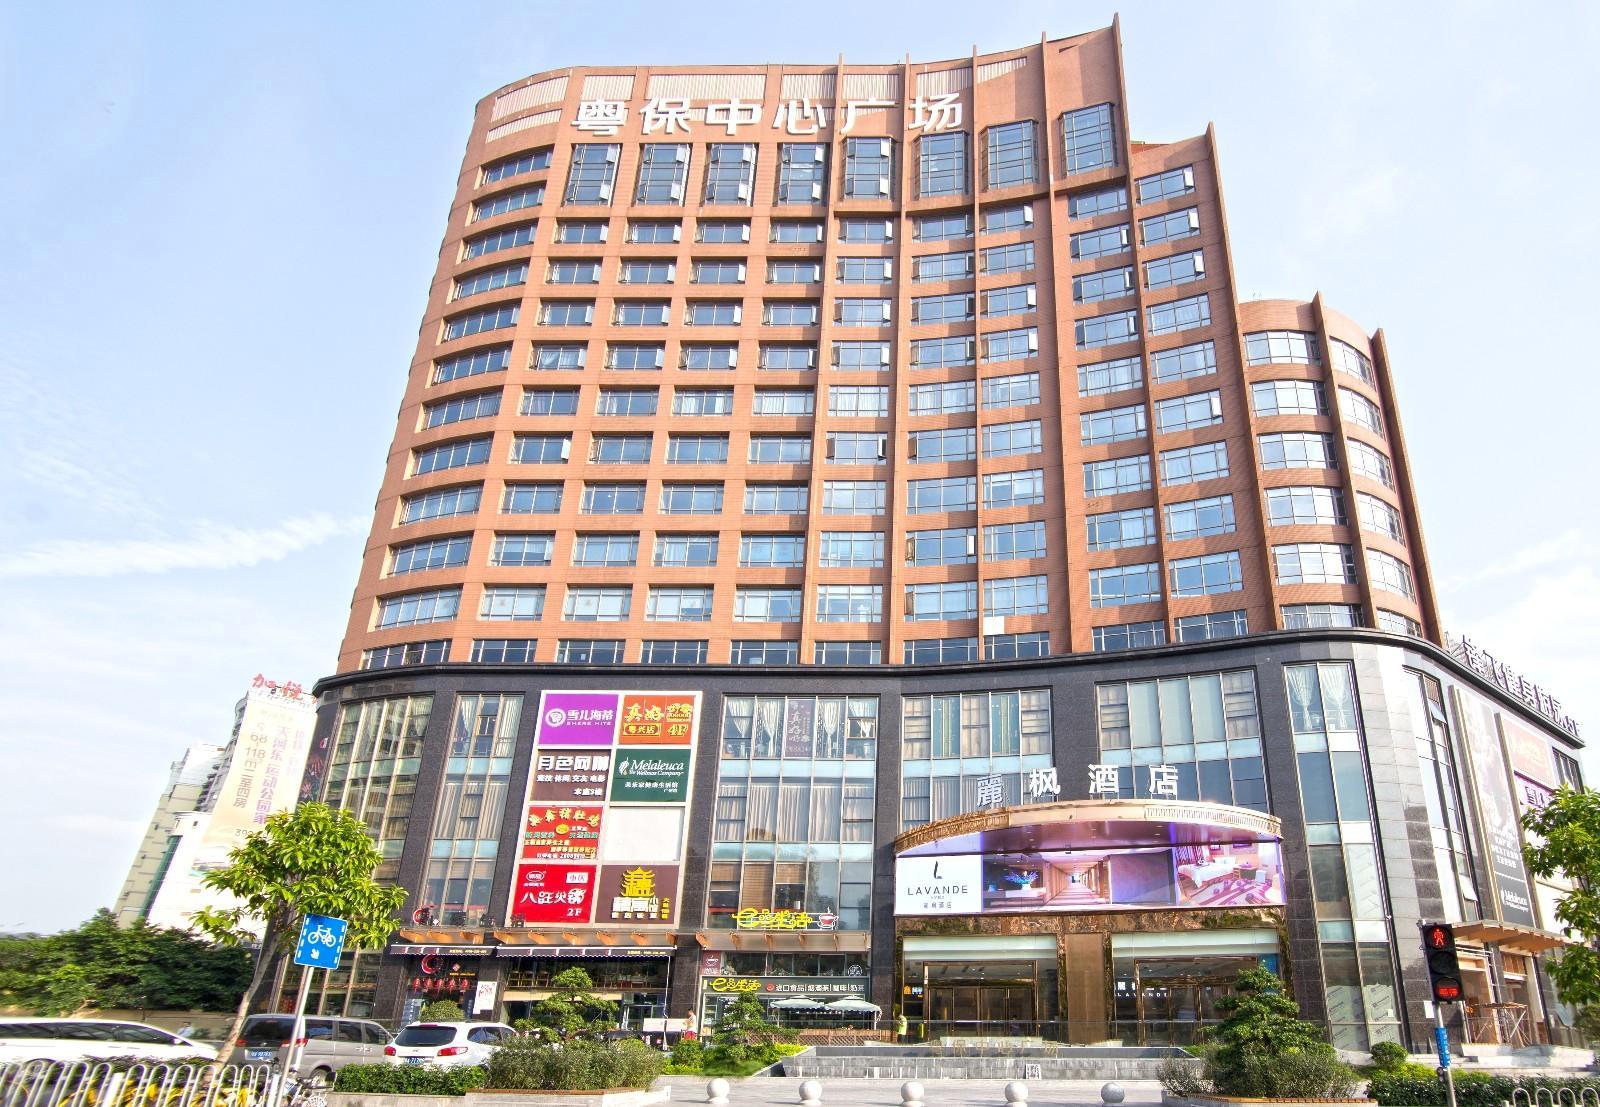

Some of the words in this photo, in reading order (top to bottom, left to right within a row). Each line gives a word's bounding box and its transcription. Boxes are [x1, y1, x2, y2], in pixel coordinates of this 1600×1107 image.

[571, 93, 963, 136] 粤保中心广场
[630, 759, 684, 771] Melaleuca
[907, 885, 968, 896] LAVANDE
[567, 907, 582, 917] 2F
